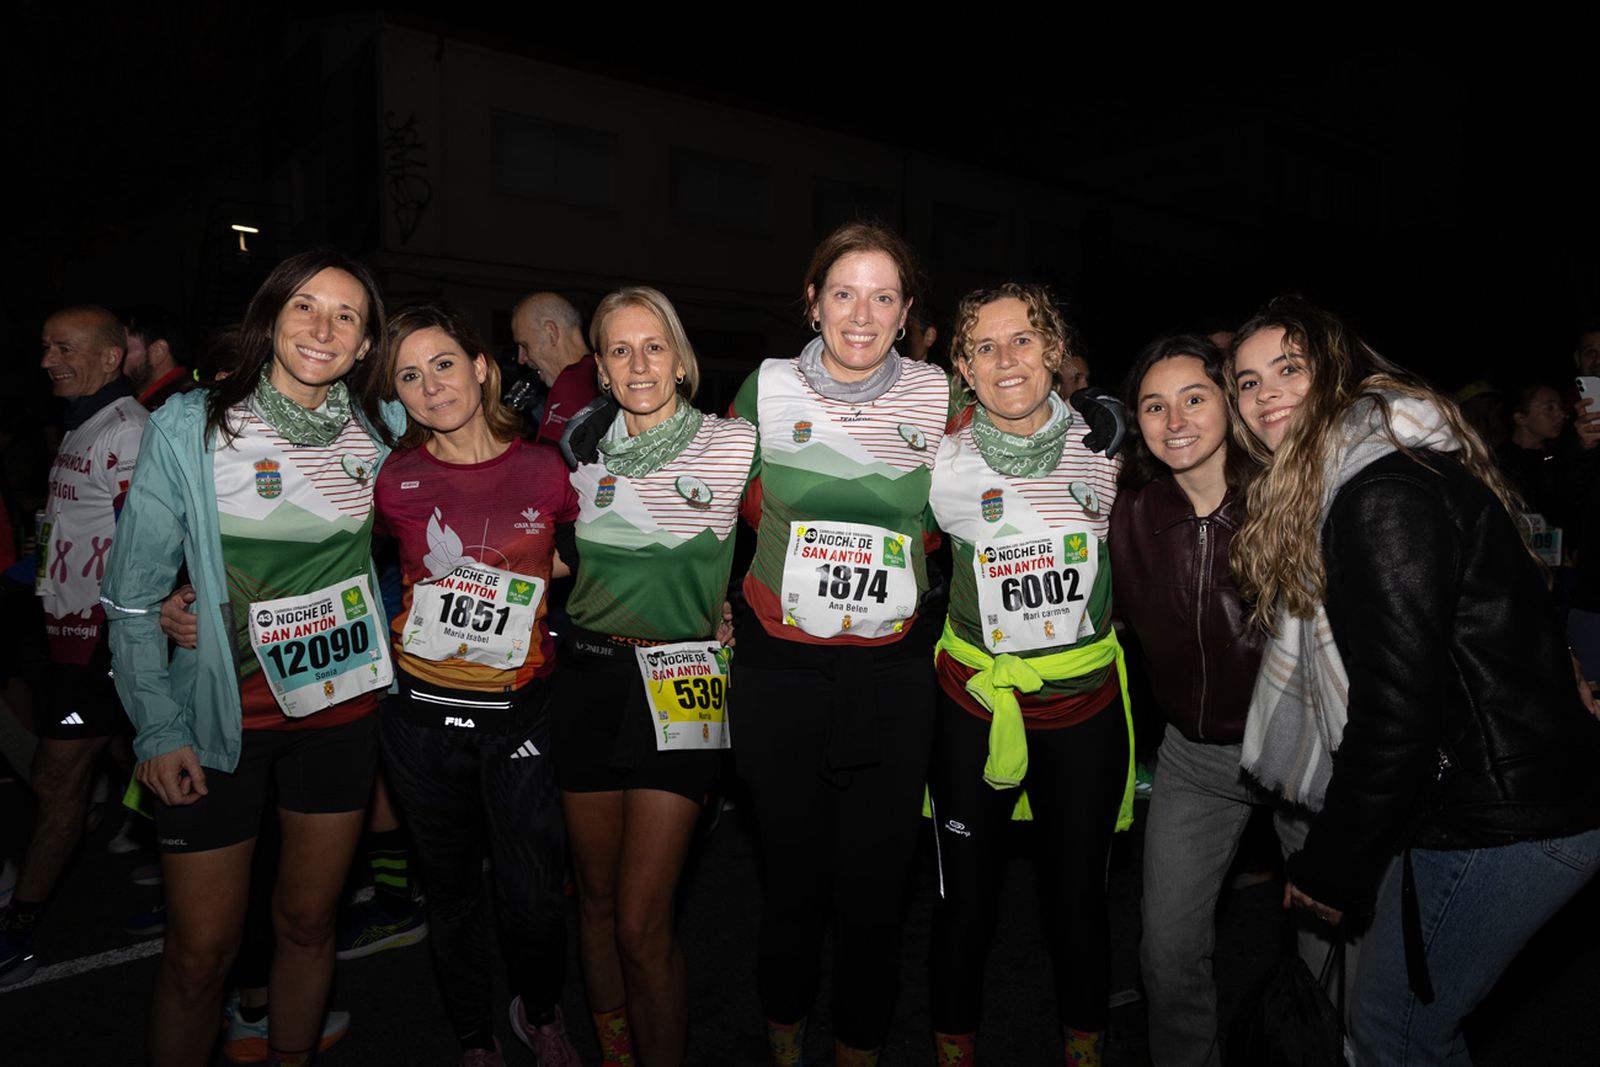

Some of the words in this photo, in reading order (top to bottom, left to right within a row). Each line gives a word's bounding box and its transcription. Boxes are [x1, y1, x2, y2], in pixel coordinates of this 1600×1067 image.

[818, 534, 856, 548] NOCHE
[858, 538, 873, 550] DE
[998, 545, 1036, 562] NOCHE
[1038, 542, 1053, 555] DE
[802, 546, 828, 560] SAN
[829, 547, 872, 565] ANTÓN
[988, 564, 1012, 578] SAN
[1014, 555, 1055, 575] ANTÓN
[452, 567, 484, 583] OCHE
[485, 574, 500, 587] DE
[815, 563, 889, 604] 1874
[455, 580, 497, 600] ANTÓN
[1001, 567, 1084, 612] 6002
[276, 606, 317, 626] NOCHE
[320, 601, 334, 616] DE
[439, 592, 511, 636] 1851
[828, 602, 844, 611] Ana
[846, 602, 868, 614] Belen
[1023, 611, 1040, 621] Mari
[261, 627, 290, 644] SAN
[293, 615, 337, 638] ANTÓN
[466, 632, 490, 644] Isabel
[267, 620, 369, 679] 12090
[661, 653, 695, 666] NOCHE
[695, 652, 708, 662] DE
[314, 668, 338, 681] Sonia
[652, 667, 675, 681] SAN
[677, 661, 711, 677] ANTÓN
[673, 677, 723, 710] 539
[444, 716, 476, 728] FILA
